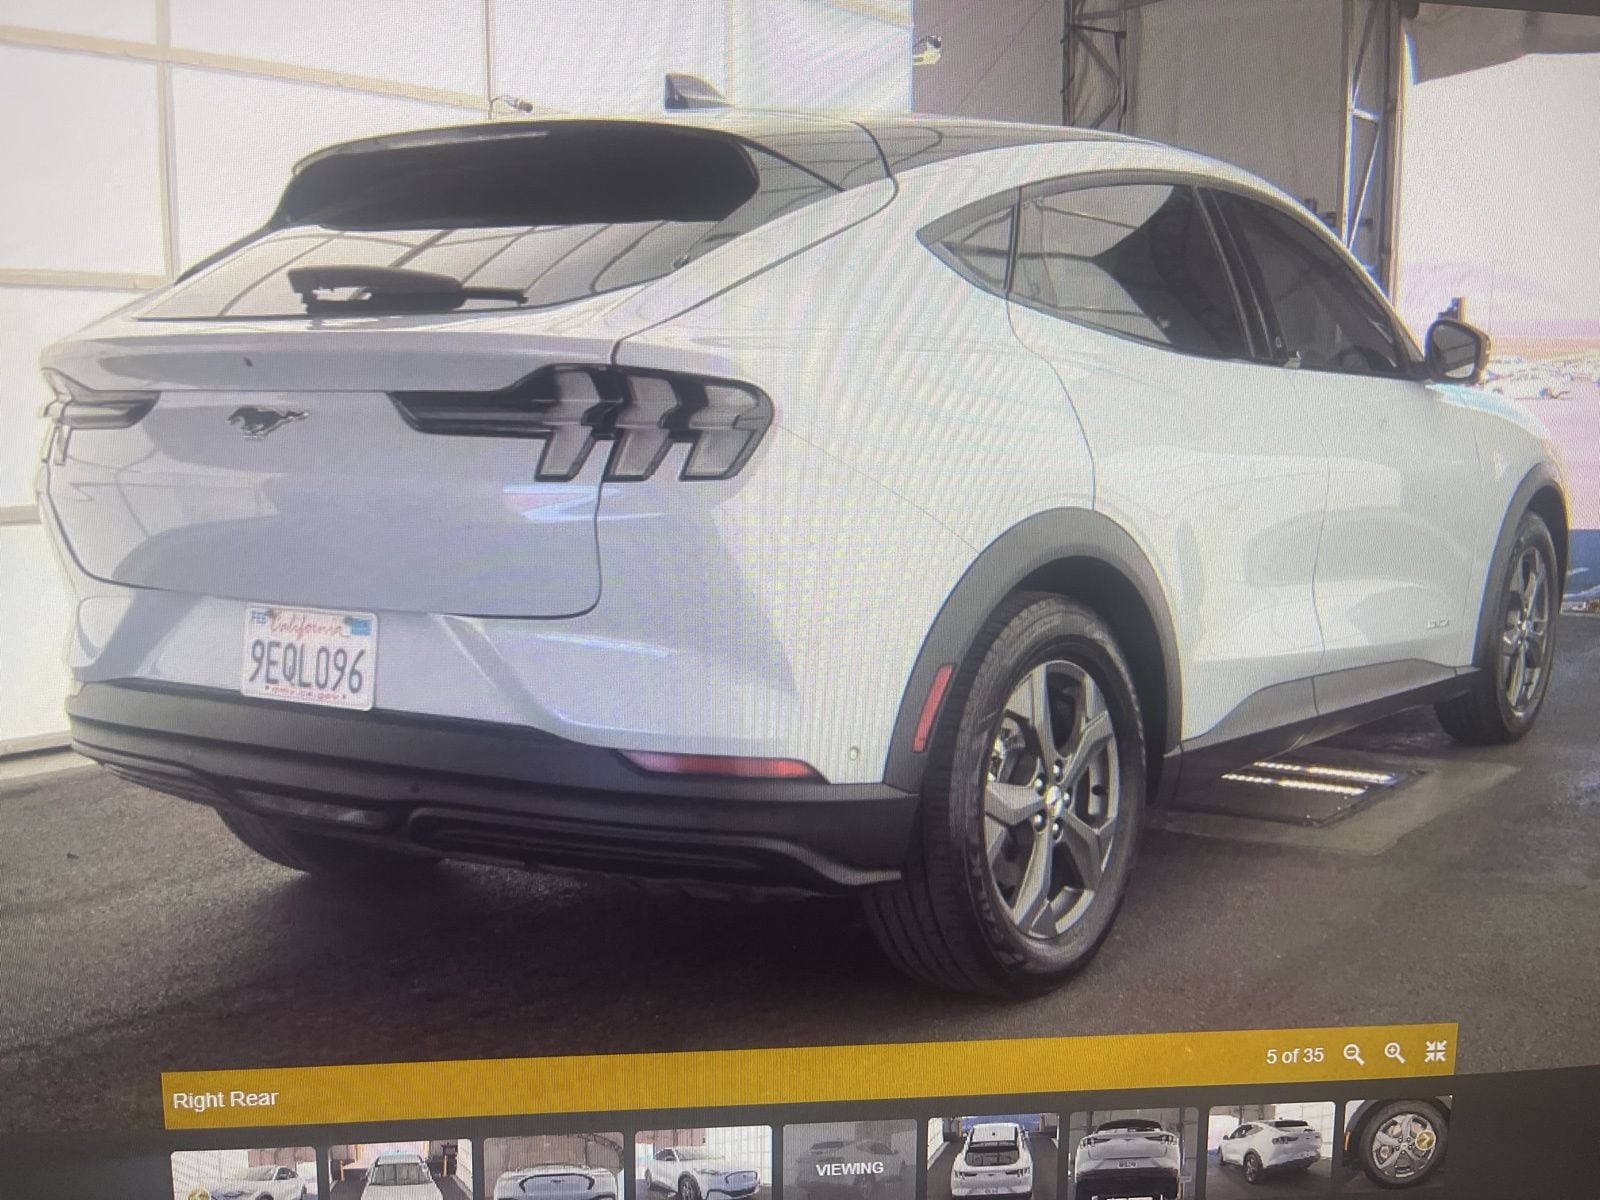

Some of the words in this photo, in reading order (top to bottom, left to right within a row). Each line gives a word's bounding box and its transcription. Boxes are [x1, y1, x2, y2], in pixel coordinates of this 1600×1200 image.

[270, 611, 349, 640] California
[248, 638, 366, 694] 9EQL096
[1265, 1049, 1278, 1065] 5
[1281, 1048, 1300, 1065] of
[1303, 1047, 1325, 1064] 35
[172, 1091, 225, 1113] Right
[230, 1090, 279, 1108] Rear
[815, 1161, 885, 1177] VIEWING
